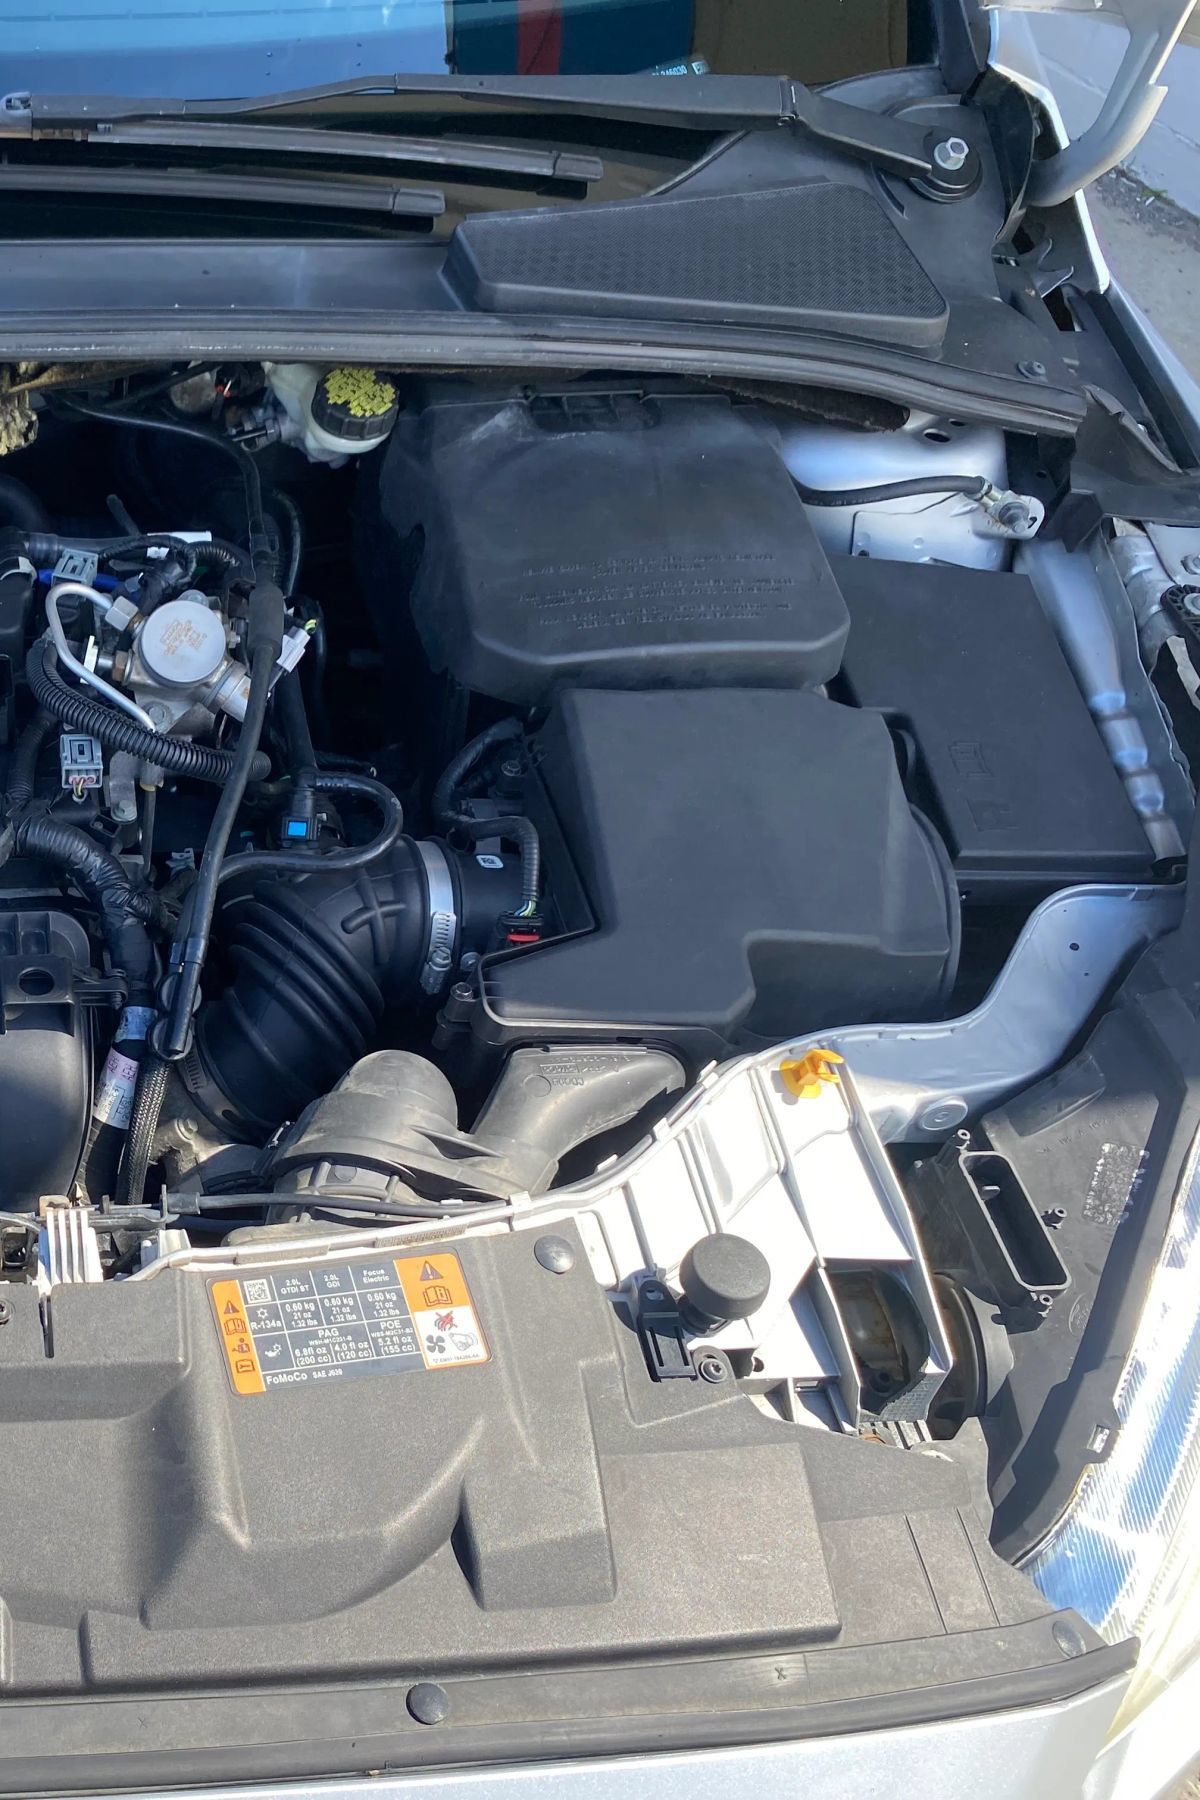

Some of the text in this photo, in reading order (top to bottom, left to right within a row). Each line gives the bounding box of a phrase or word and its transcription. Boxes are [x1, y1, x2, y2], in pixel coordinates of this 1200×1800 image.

[363, 1268, 385, 1277] Focus
[363, 1274, 390, 1284] Electric
[323, 1296, 354, 1307] 0.60 kg
[367, 1291, 397, 1302] 0.60 kg
[285, 1301, 316, 1312] 0.60 kg
[332, 1306, 340, 1314] 21
[293, 1312, 302, 1320] 21
[330, 1313, 357, 1322] 1.32 lbs
[373, 1308, 400, 1318] 1.32 lbs
[250, 1319, 282, 1330] R-134a
[291, 1320, 306, 1328] 1.32
[380, 1319, 402, 1330] POE
[318, 1328, 339, 1338] PAG
[378, 1335, 412, 1346] 5.2 fl oz
[316, 1346, 327, 1355] oz
[334, 1341, 369, 1352] 4.0 fl oz
[381, 1342, 416, 1356] (155 cc)
[296, 1353, 332, 1367] (200 cc)
[337, 1348, 372, 1362] (120 cc)
[266, 1372, 308, 1385] FoMoCo
[312, 1370, 327, 1379] SAE
